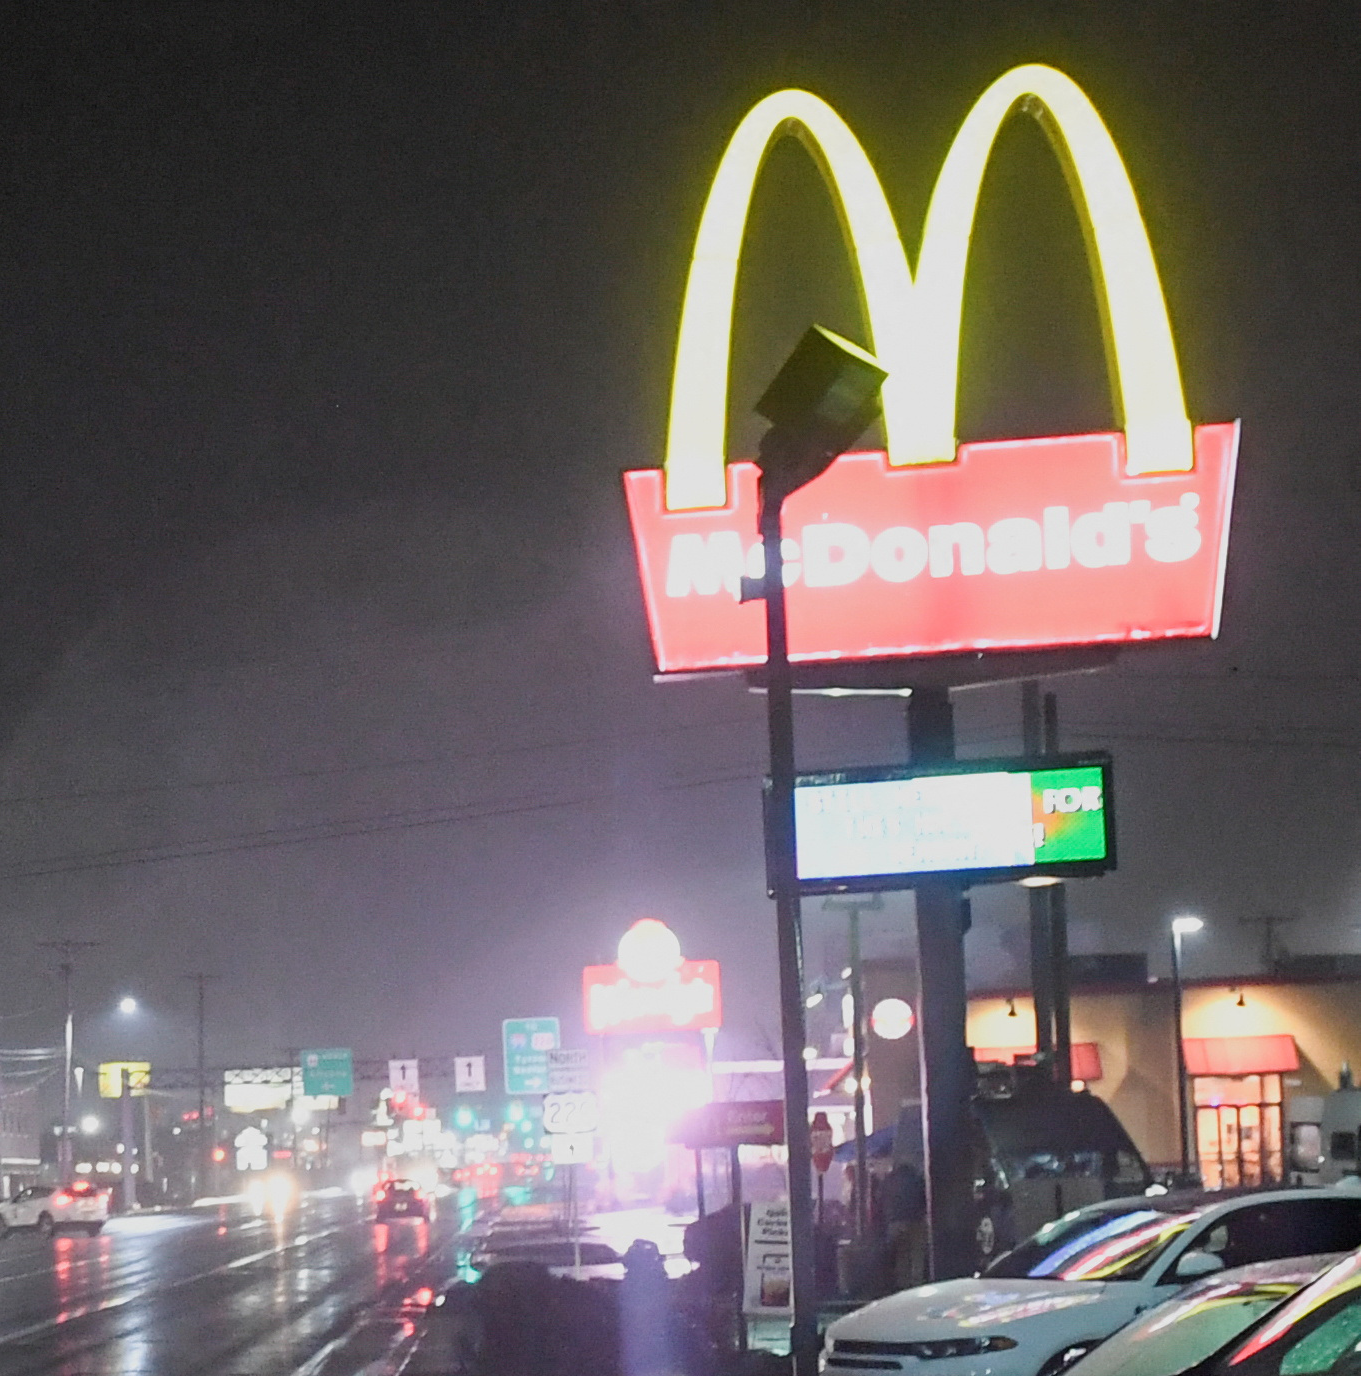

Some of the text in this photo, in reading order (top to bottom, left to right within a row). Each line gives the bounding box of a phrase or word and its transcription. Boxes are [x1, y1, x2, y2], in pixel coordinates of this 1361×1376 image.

[665, 492, 1202, 601] McDonald's
[1042, 785, 1103, 815] FOR
[548, 1101, 590, 1124] 22
